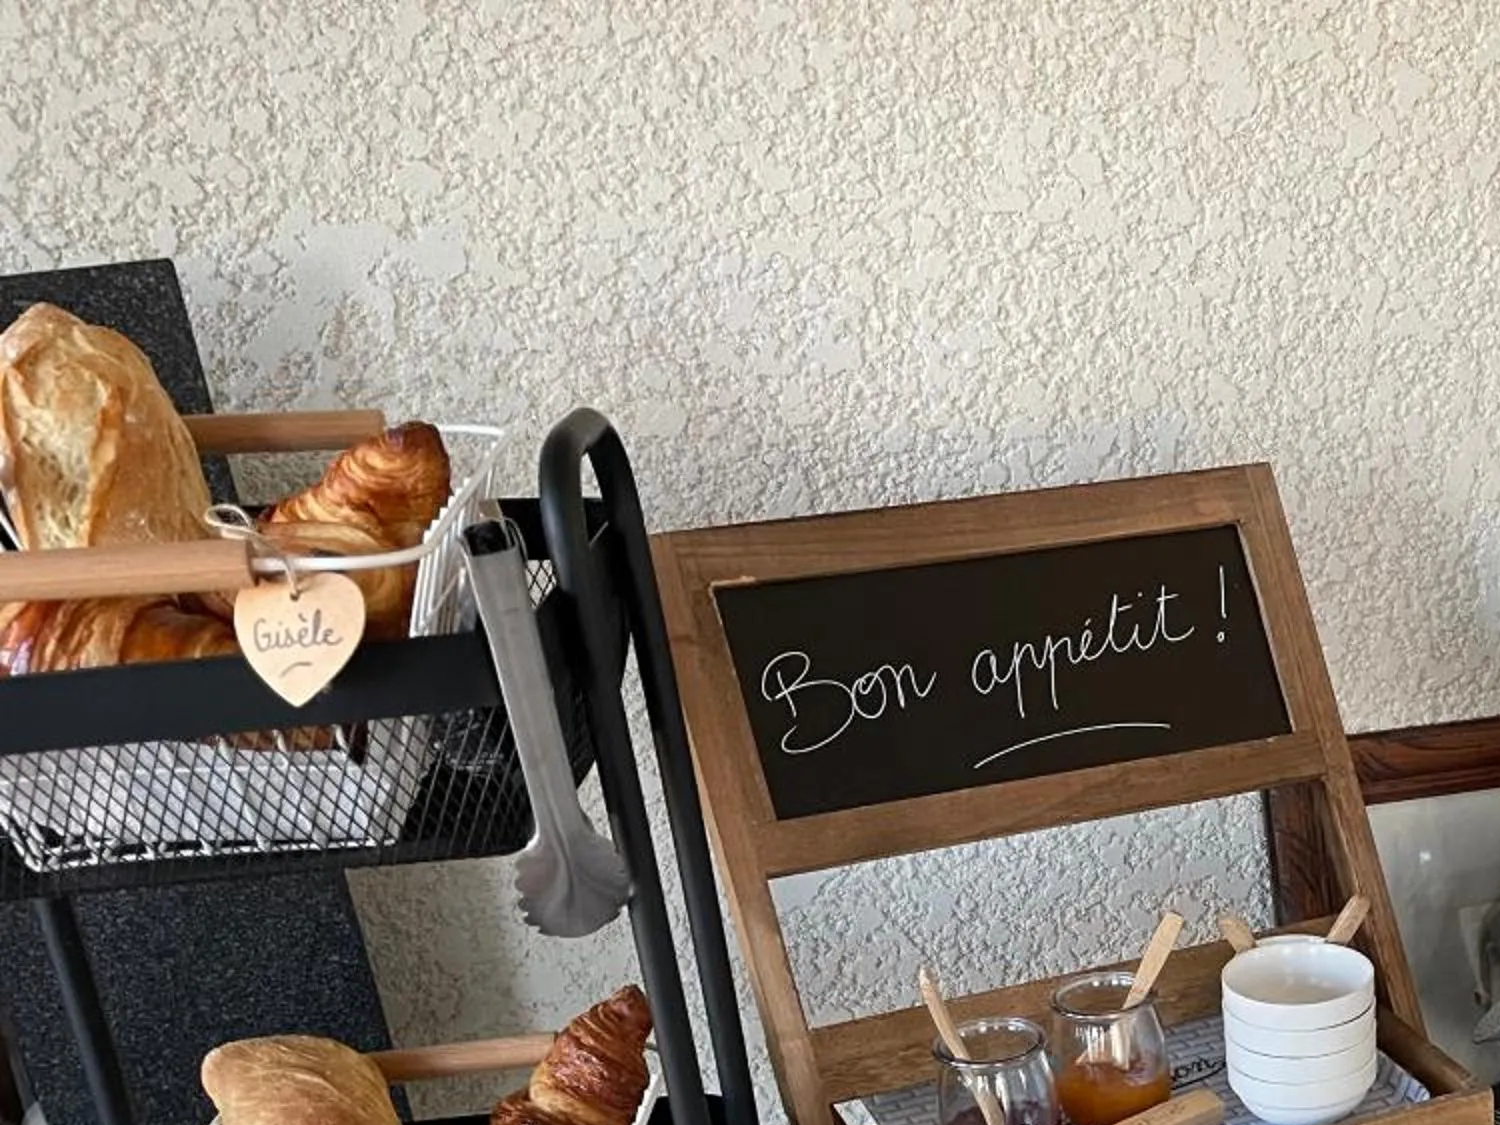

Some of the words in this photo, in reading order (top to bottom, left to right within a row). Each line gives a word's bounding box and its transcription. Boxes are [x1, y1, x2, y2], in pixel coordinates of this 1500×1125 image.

[253, 608, 343, 653] Gisèle
[761, 651, 937, 753] Bon
[971, 585, 1195, 718] appétit
[1215, 565, 1227, 643] !
